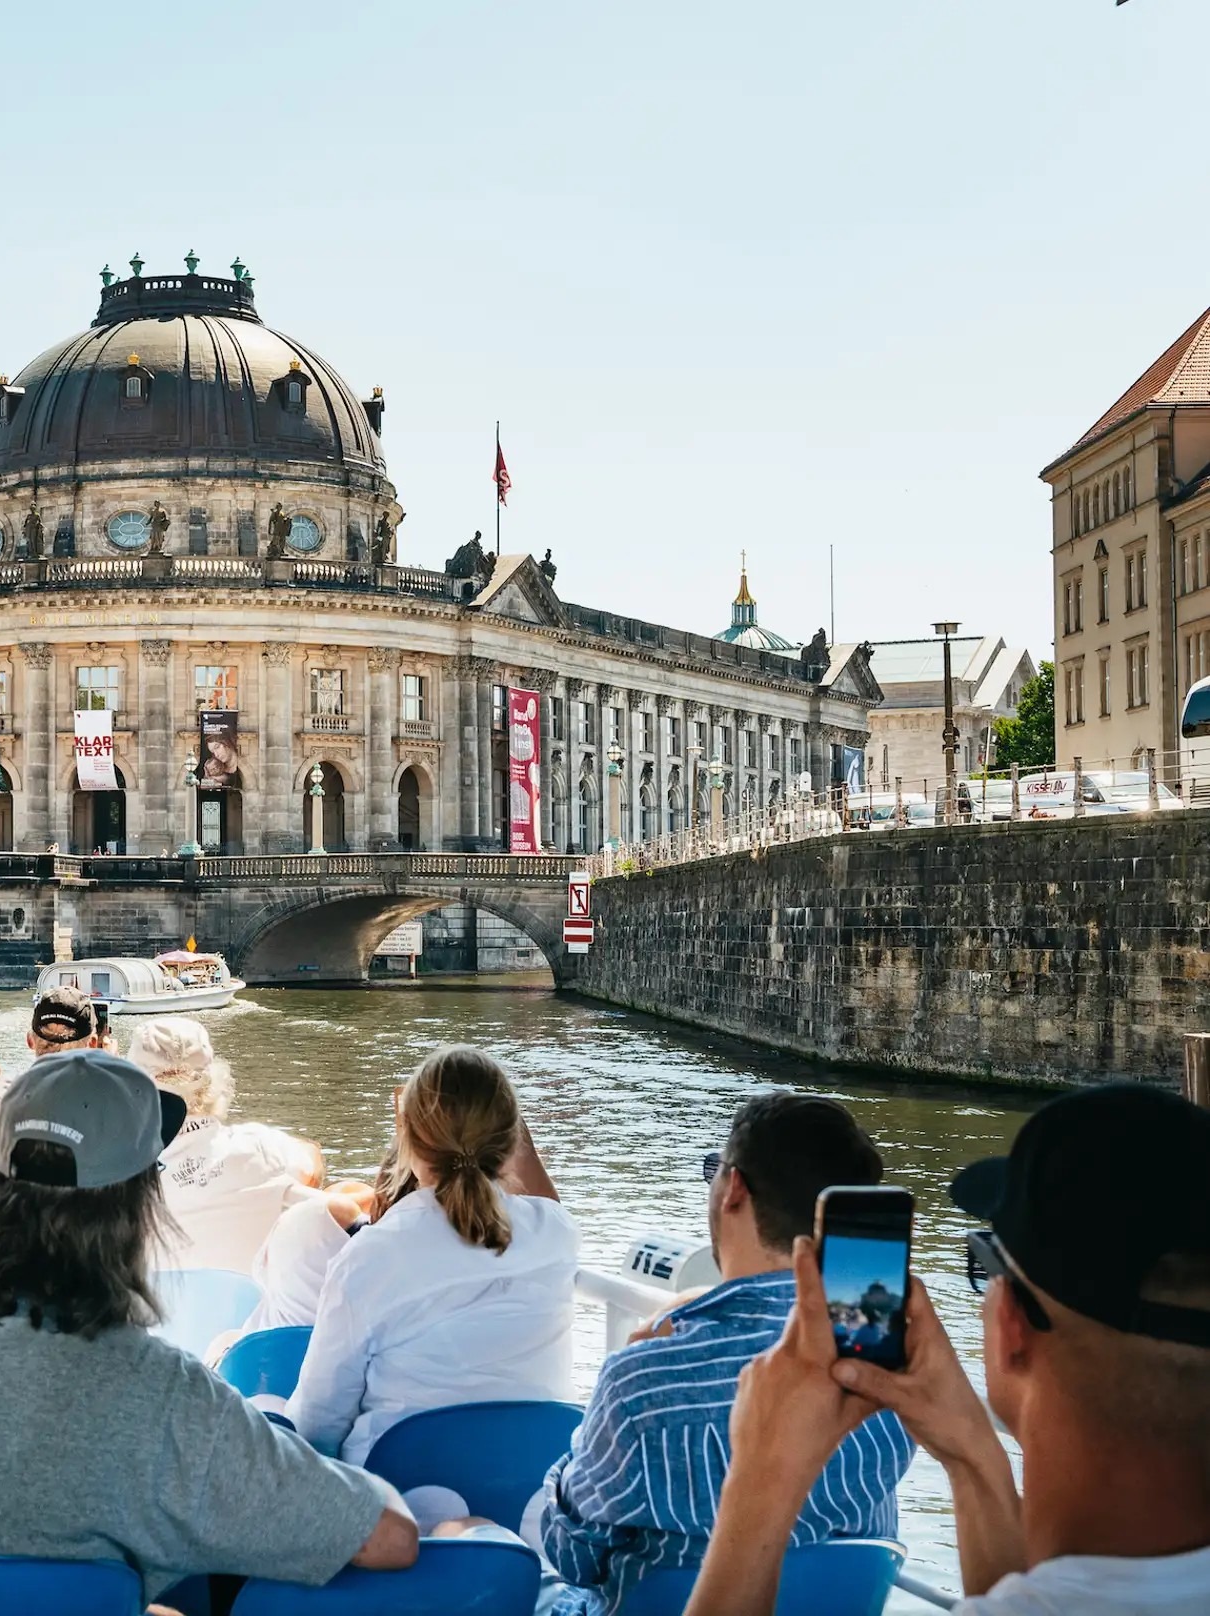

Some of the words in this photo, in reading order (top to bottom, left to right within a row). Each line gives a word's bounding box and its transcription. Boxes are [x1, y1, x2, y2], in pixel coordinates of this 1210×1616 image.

[74, 735, 113, 746] KLAR
[75, 746, 113, 757] TEXT
[50, 1122, 84, 1144] TOWERS
